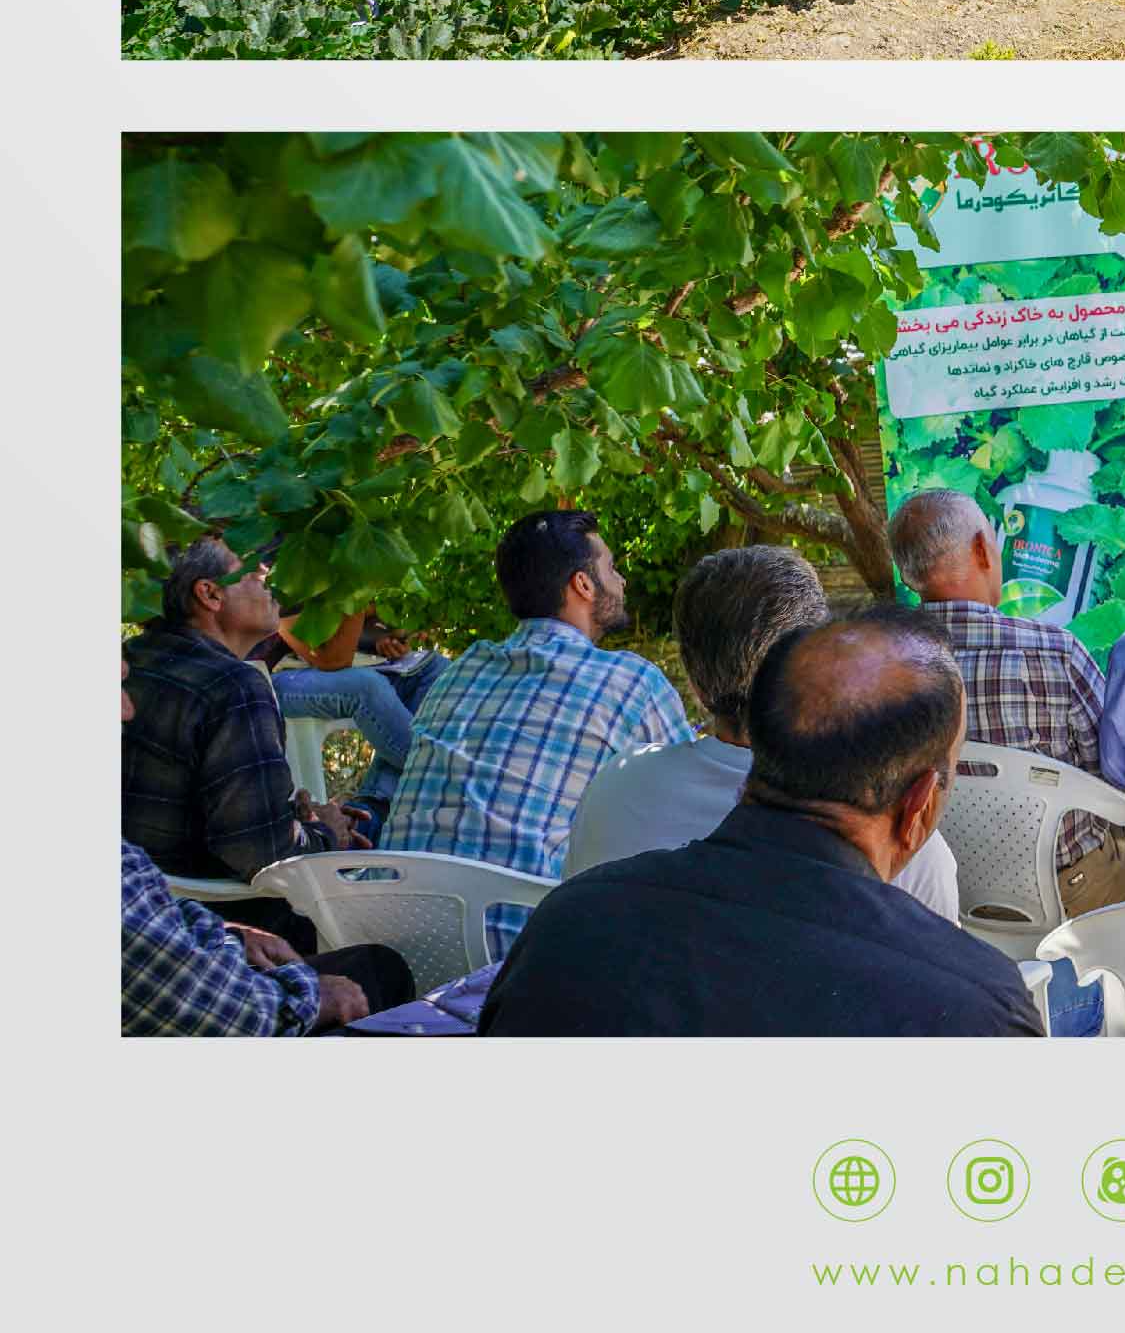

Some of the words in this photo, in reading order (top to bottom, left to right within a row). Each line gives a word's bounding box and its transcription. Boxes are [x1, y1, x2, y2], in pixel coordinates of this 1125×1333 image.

[963, 309, 1008, 331] زندگی
[1010, 306, 1043, 325] خاک
[1048, 307, 1064, 322] به
[1068, 302, 1125, 323] محصول
[935, 317, 960, 334] می
[982, 336, 1014, 352] عوامل
[1017, 333, 1040, 349] برابر
[1043, 332, 1054, 346] در
[1056, 329, 1096, 345] گیاهان
[994, 364, 1001, 376] و
[1085, 380, 1091, 392] و
